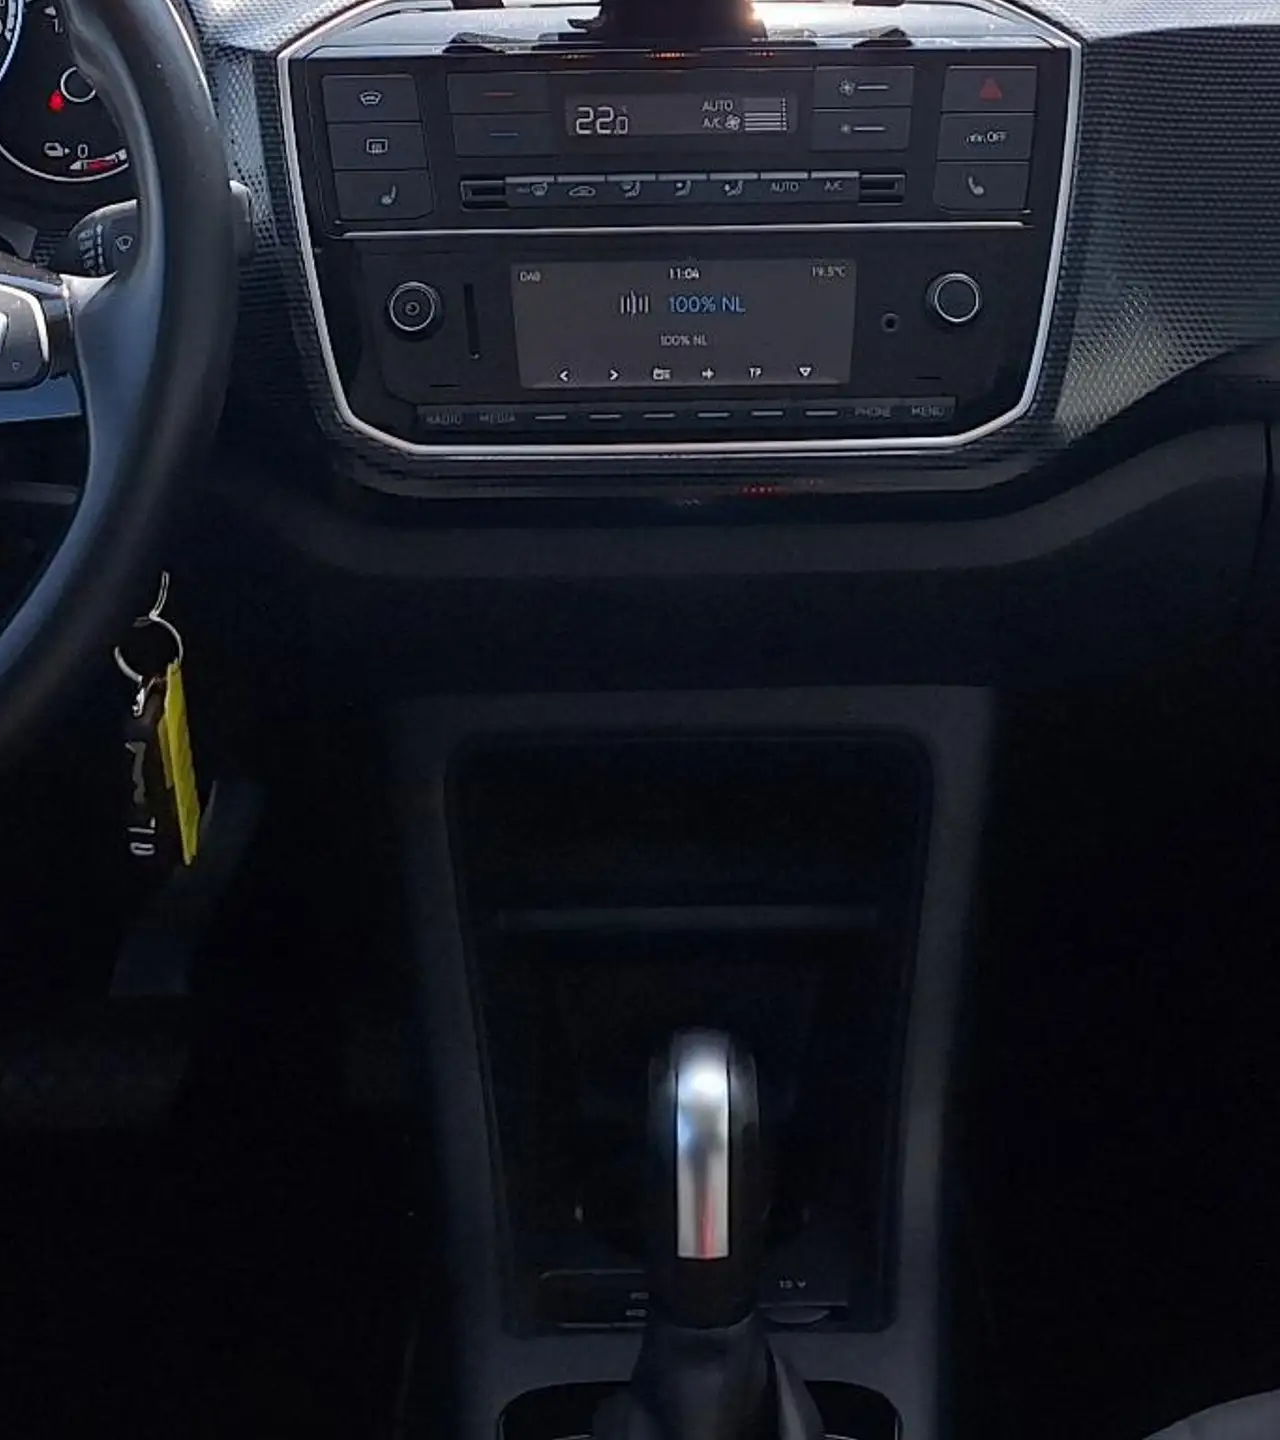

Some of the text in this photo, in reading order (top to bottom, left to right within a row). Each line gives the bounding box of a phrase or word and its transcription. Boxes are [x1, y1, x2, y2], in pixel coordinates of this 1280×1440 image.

[703, 99, 734, 111] AUTO
[77, 143, 89, 160] 0
[769, 181, 799, 193] AUTO
[669, 295, 746, 314] 100% NL
[661, 334, 690, 346] 100%
